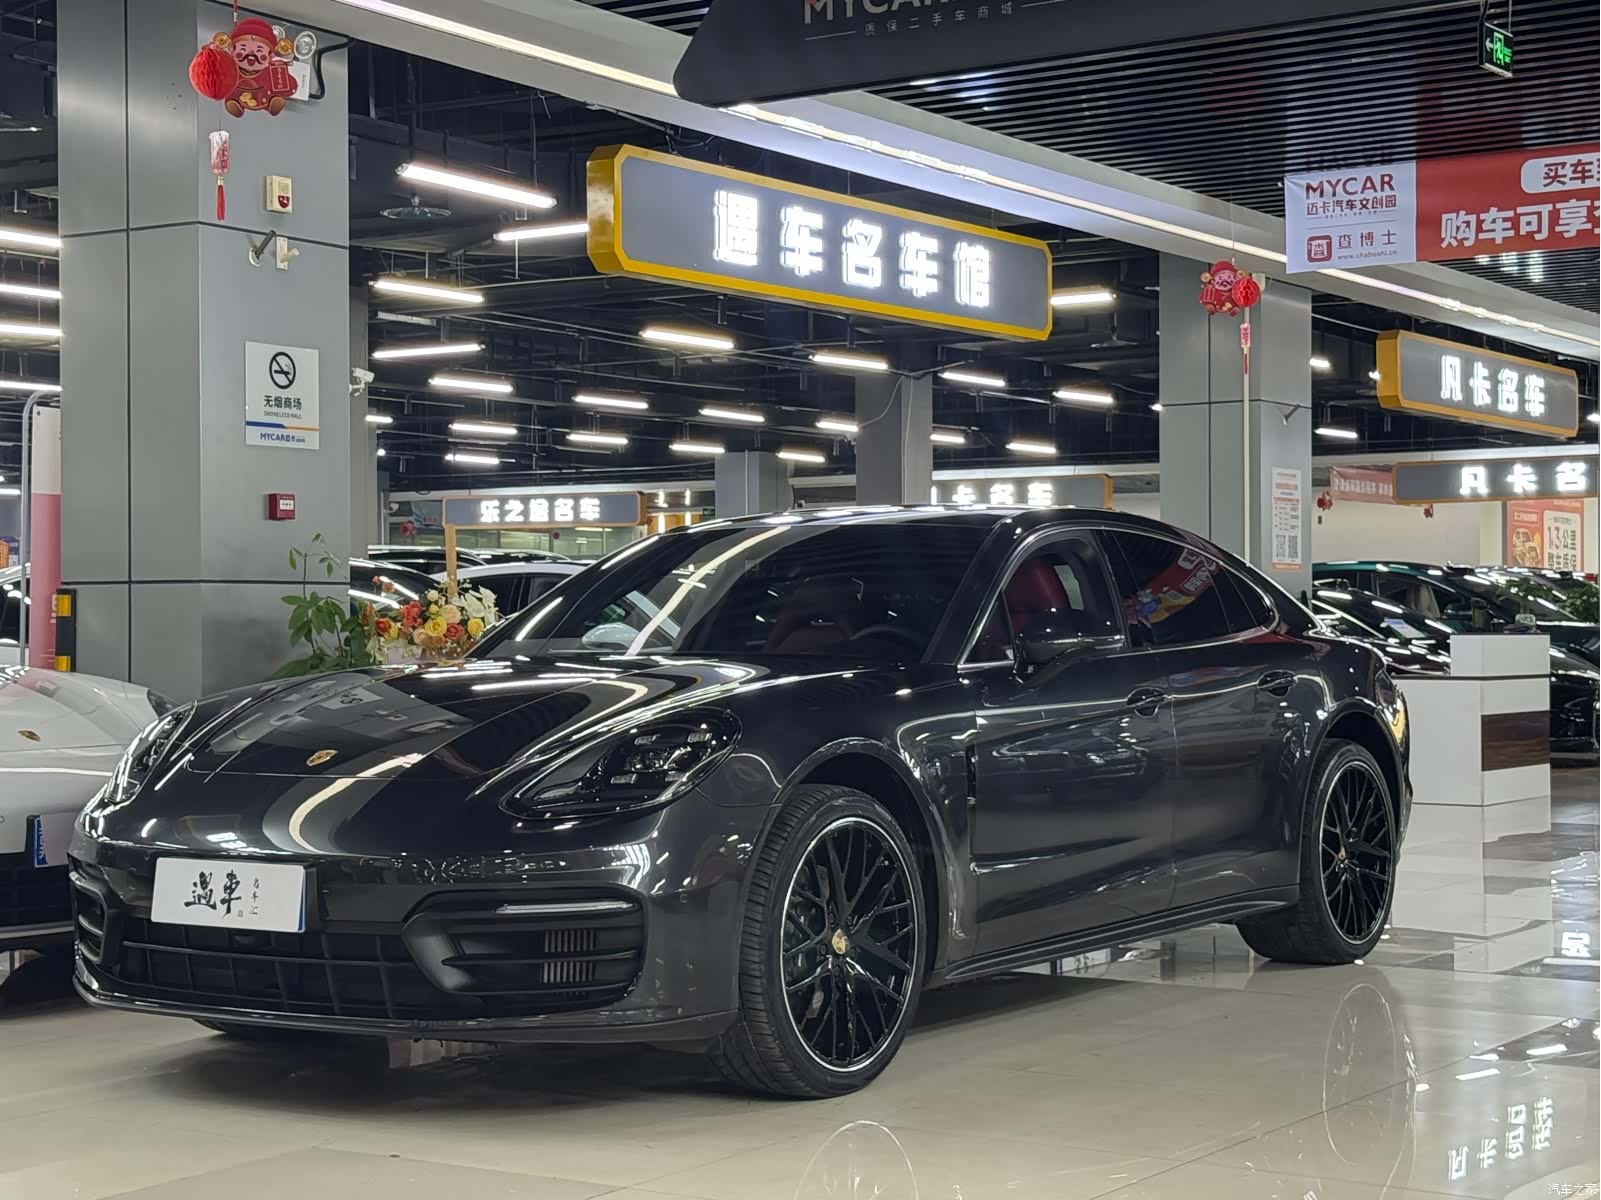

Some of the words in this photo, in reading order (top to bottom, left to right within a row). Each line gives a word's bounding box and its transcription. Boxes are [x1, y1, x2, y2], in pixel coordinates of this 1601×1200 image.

[864, 2, 1013, 37] 质保二手车商城
[1305, 174, 1395, 199] MYCAR
[1543, 157, 1600, 187] 买车
[1307, 195, 1396, 215] 迈卡汽车文创园
[1440, 198, 1600, 248] 购车可享
[713, 189, 992, 307] 遇车名车馆
[1337, 229, 1397, 249] 查博士
[1337, 249, 1398, 260] www.chaboshi.cn
[1440, 354, 1545, 417] 凡卡名车
[264, 395, 302, 410] 无烟商场
[1459, 461, 1587, 496] 凡卡名
